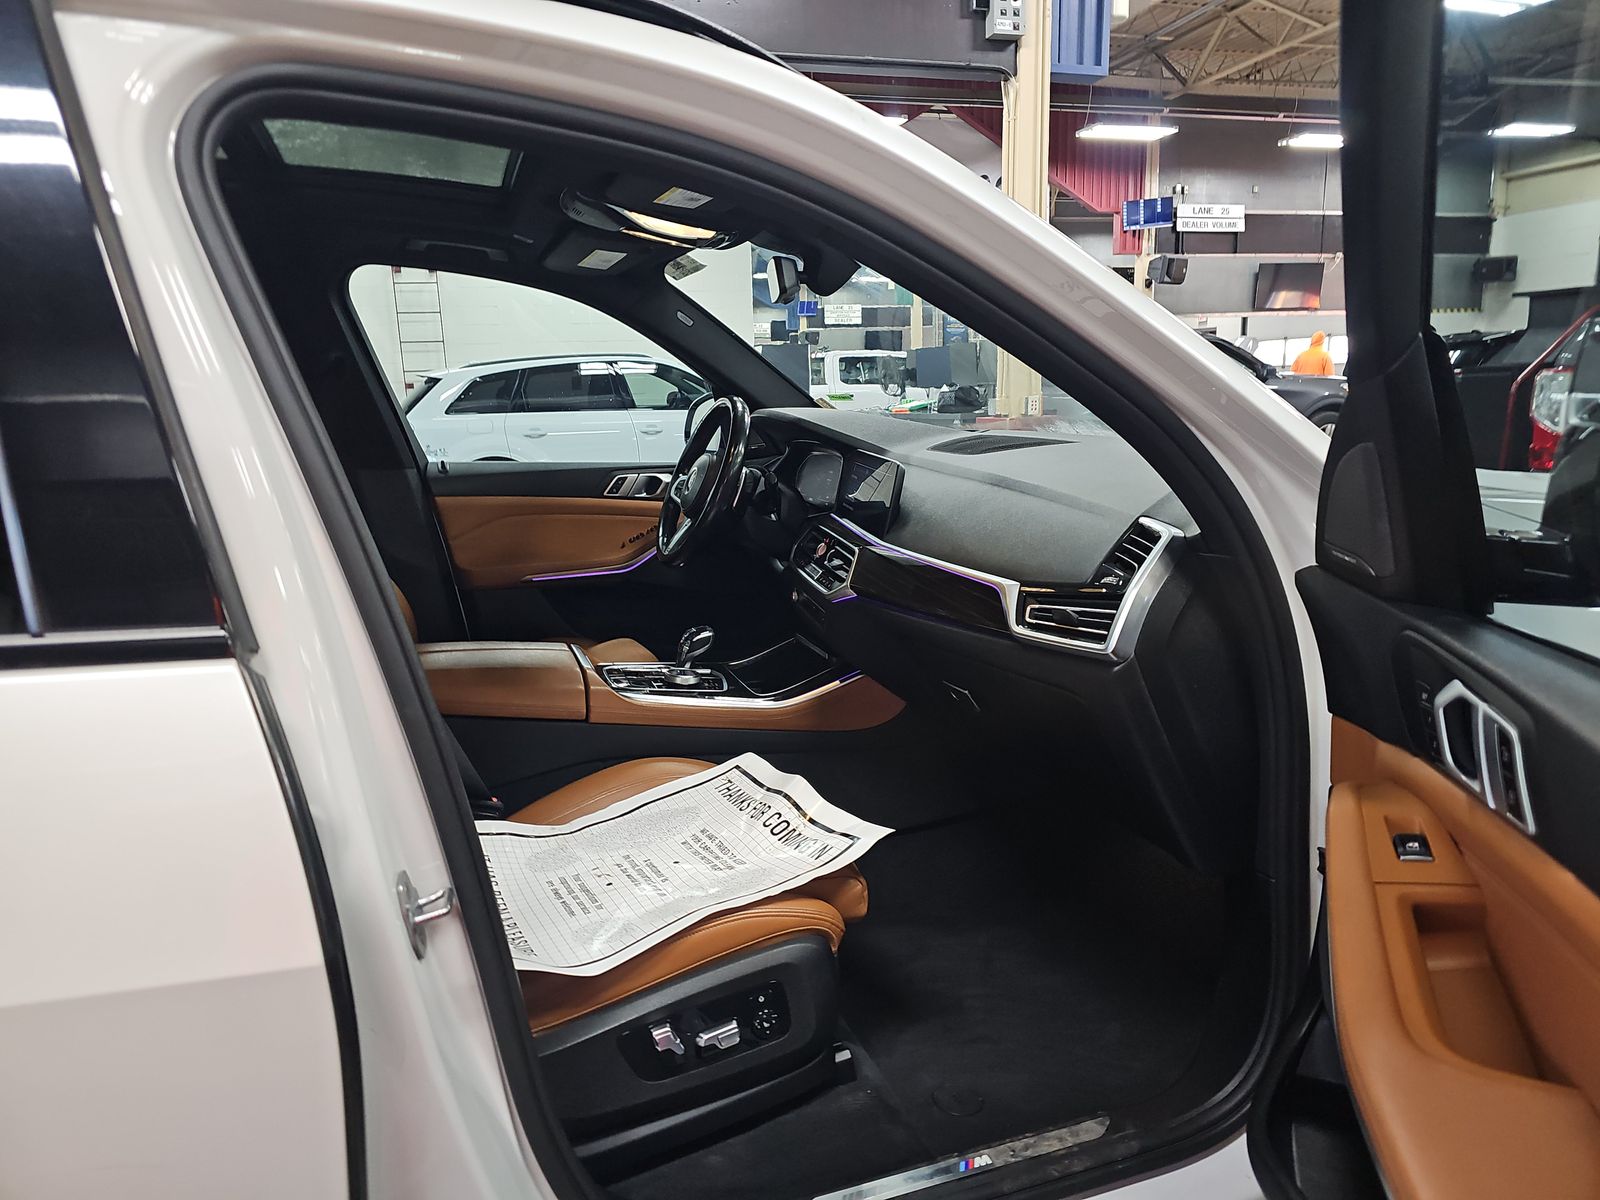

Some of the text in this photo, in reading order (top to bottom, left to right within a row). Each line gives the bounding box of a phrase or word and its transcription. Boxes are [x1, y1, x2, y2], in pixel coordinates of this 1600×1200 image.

[1192, 206, 1214, 215] LANE
[1181, 221, 1239, 229] DEALER VOLUME
[714, 778, 834, 861] THANKS FOR COMING IN
[714, 840, 732, 856] TRIED
